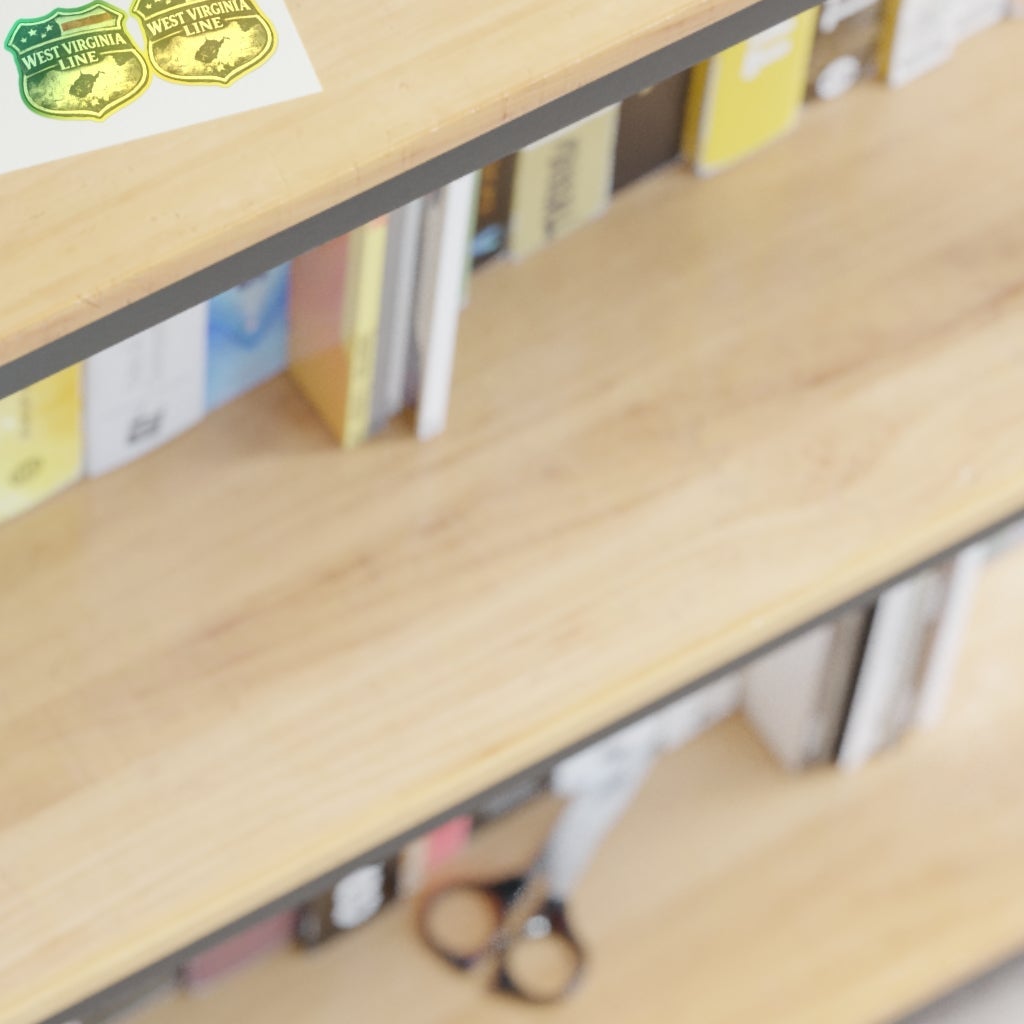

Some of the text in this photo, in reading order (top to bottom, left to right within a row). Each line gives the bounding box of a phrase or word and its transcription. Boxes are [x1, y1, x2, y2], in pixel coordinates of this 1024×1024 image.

[146, 11, 185, 36] WEST
[182, 17, 224, 37] LINE
[22, 31, 127, 71] WEST VIRGINIA
[58, 50, 100, 71] LINE
